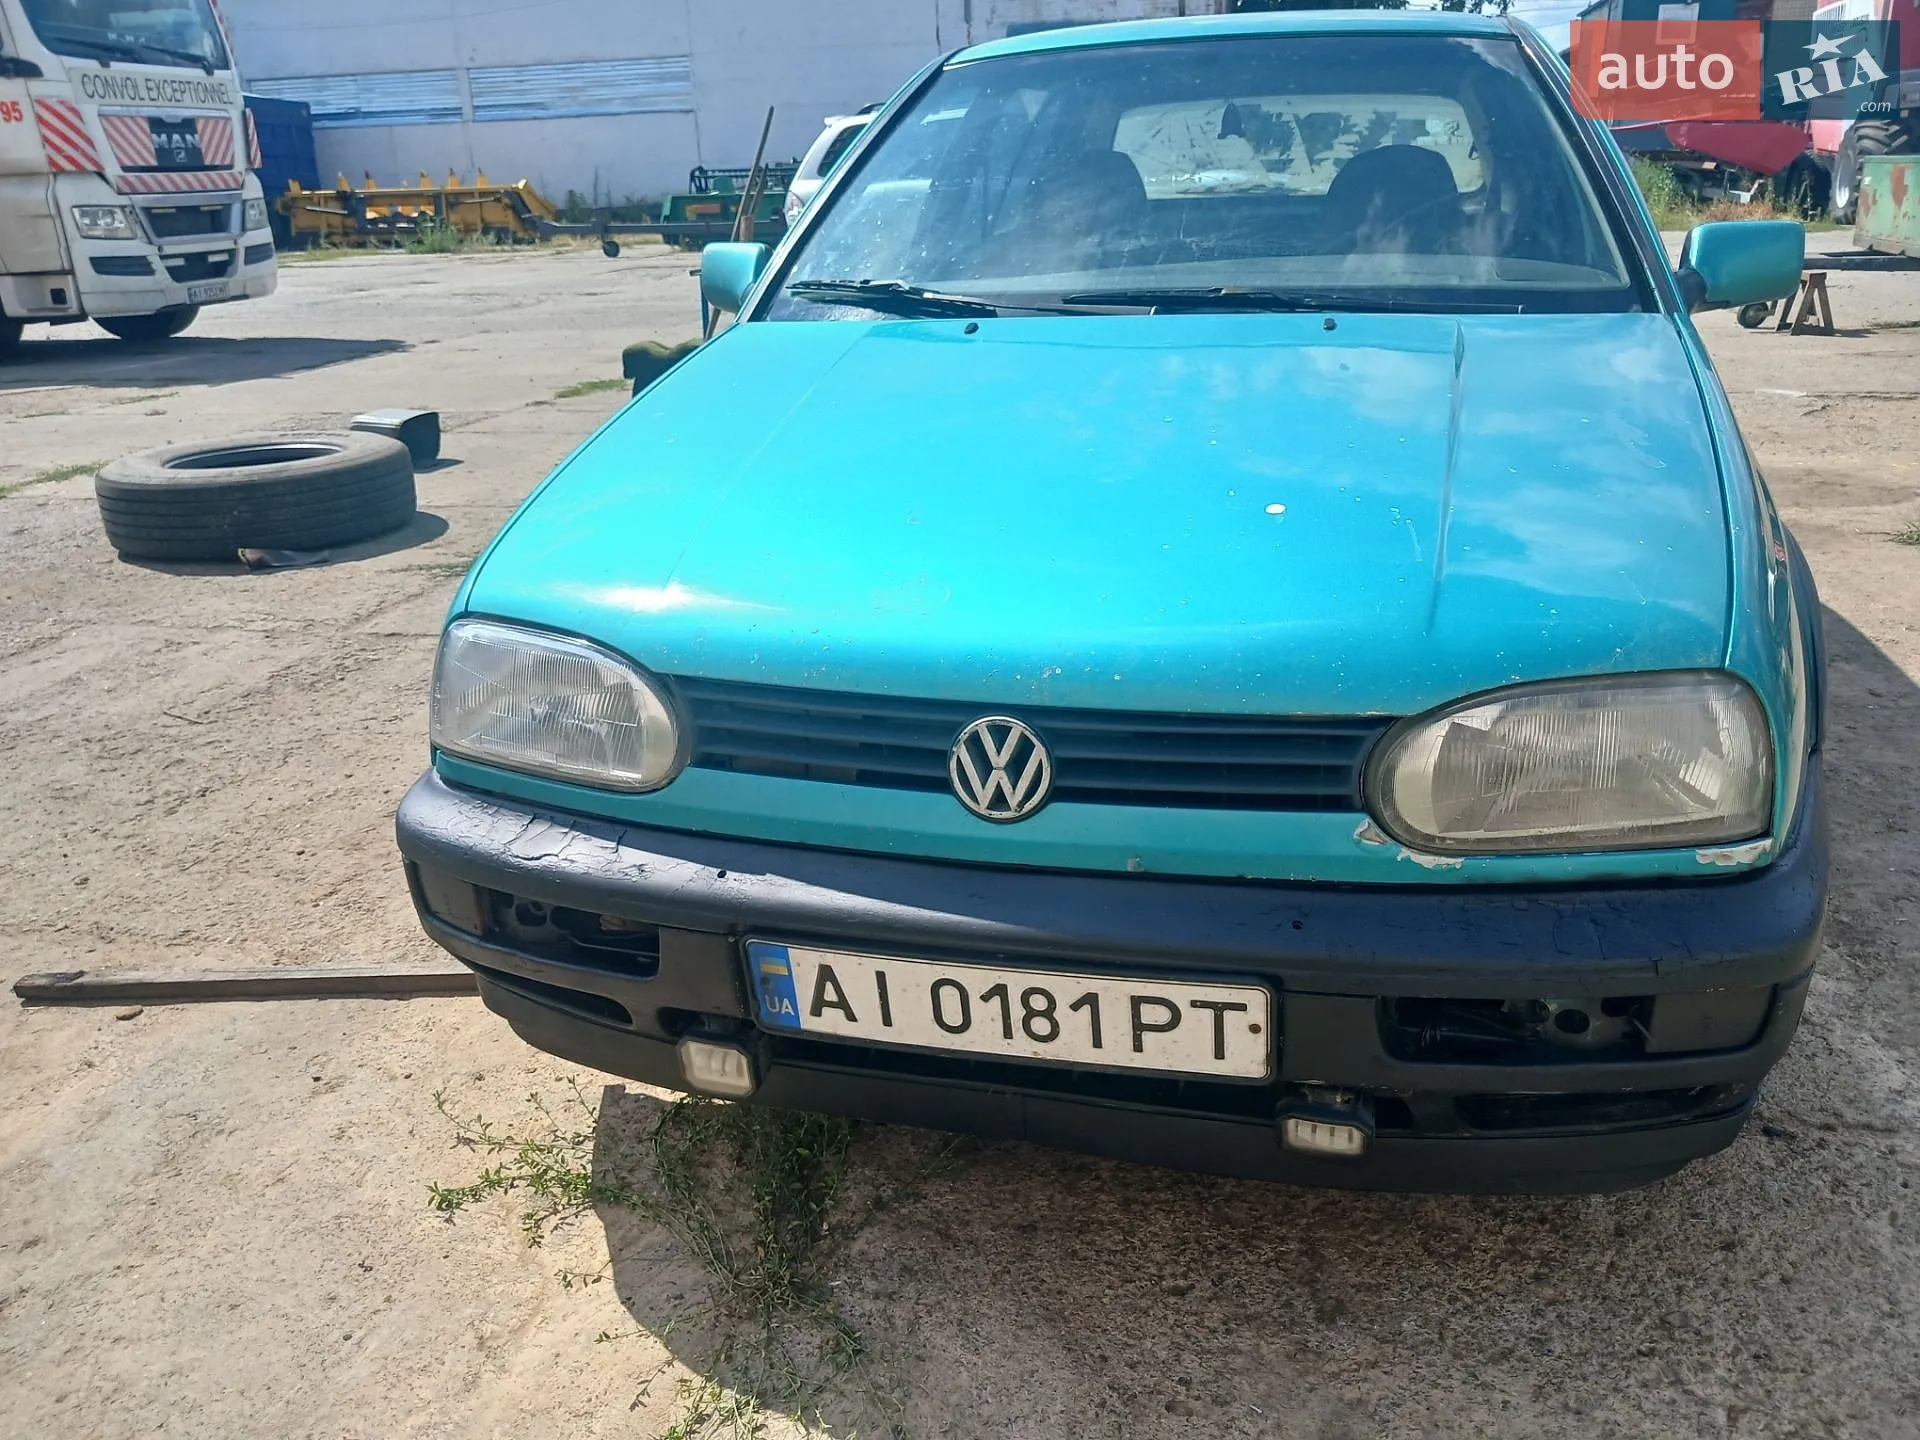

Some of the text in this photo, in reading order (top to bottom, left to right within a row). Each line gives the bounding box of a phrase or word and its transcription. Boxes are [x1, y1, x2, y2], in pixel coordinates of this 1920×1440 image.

[81, 73, 234, 105] CONVOL EXCEPTIONNEL
[151, 133, 200, 149] MAN
[765, 994, 795, 1017] UA
[809, 963, 1248, 1061] AI 0181 PT
